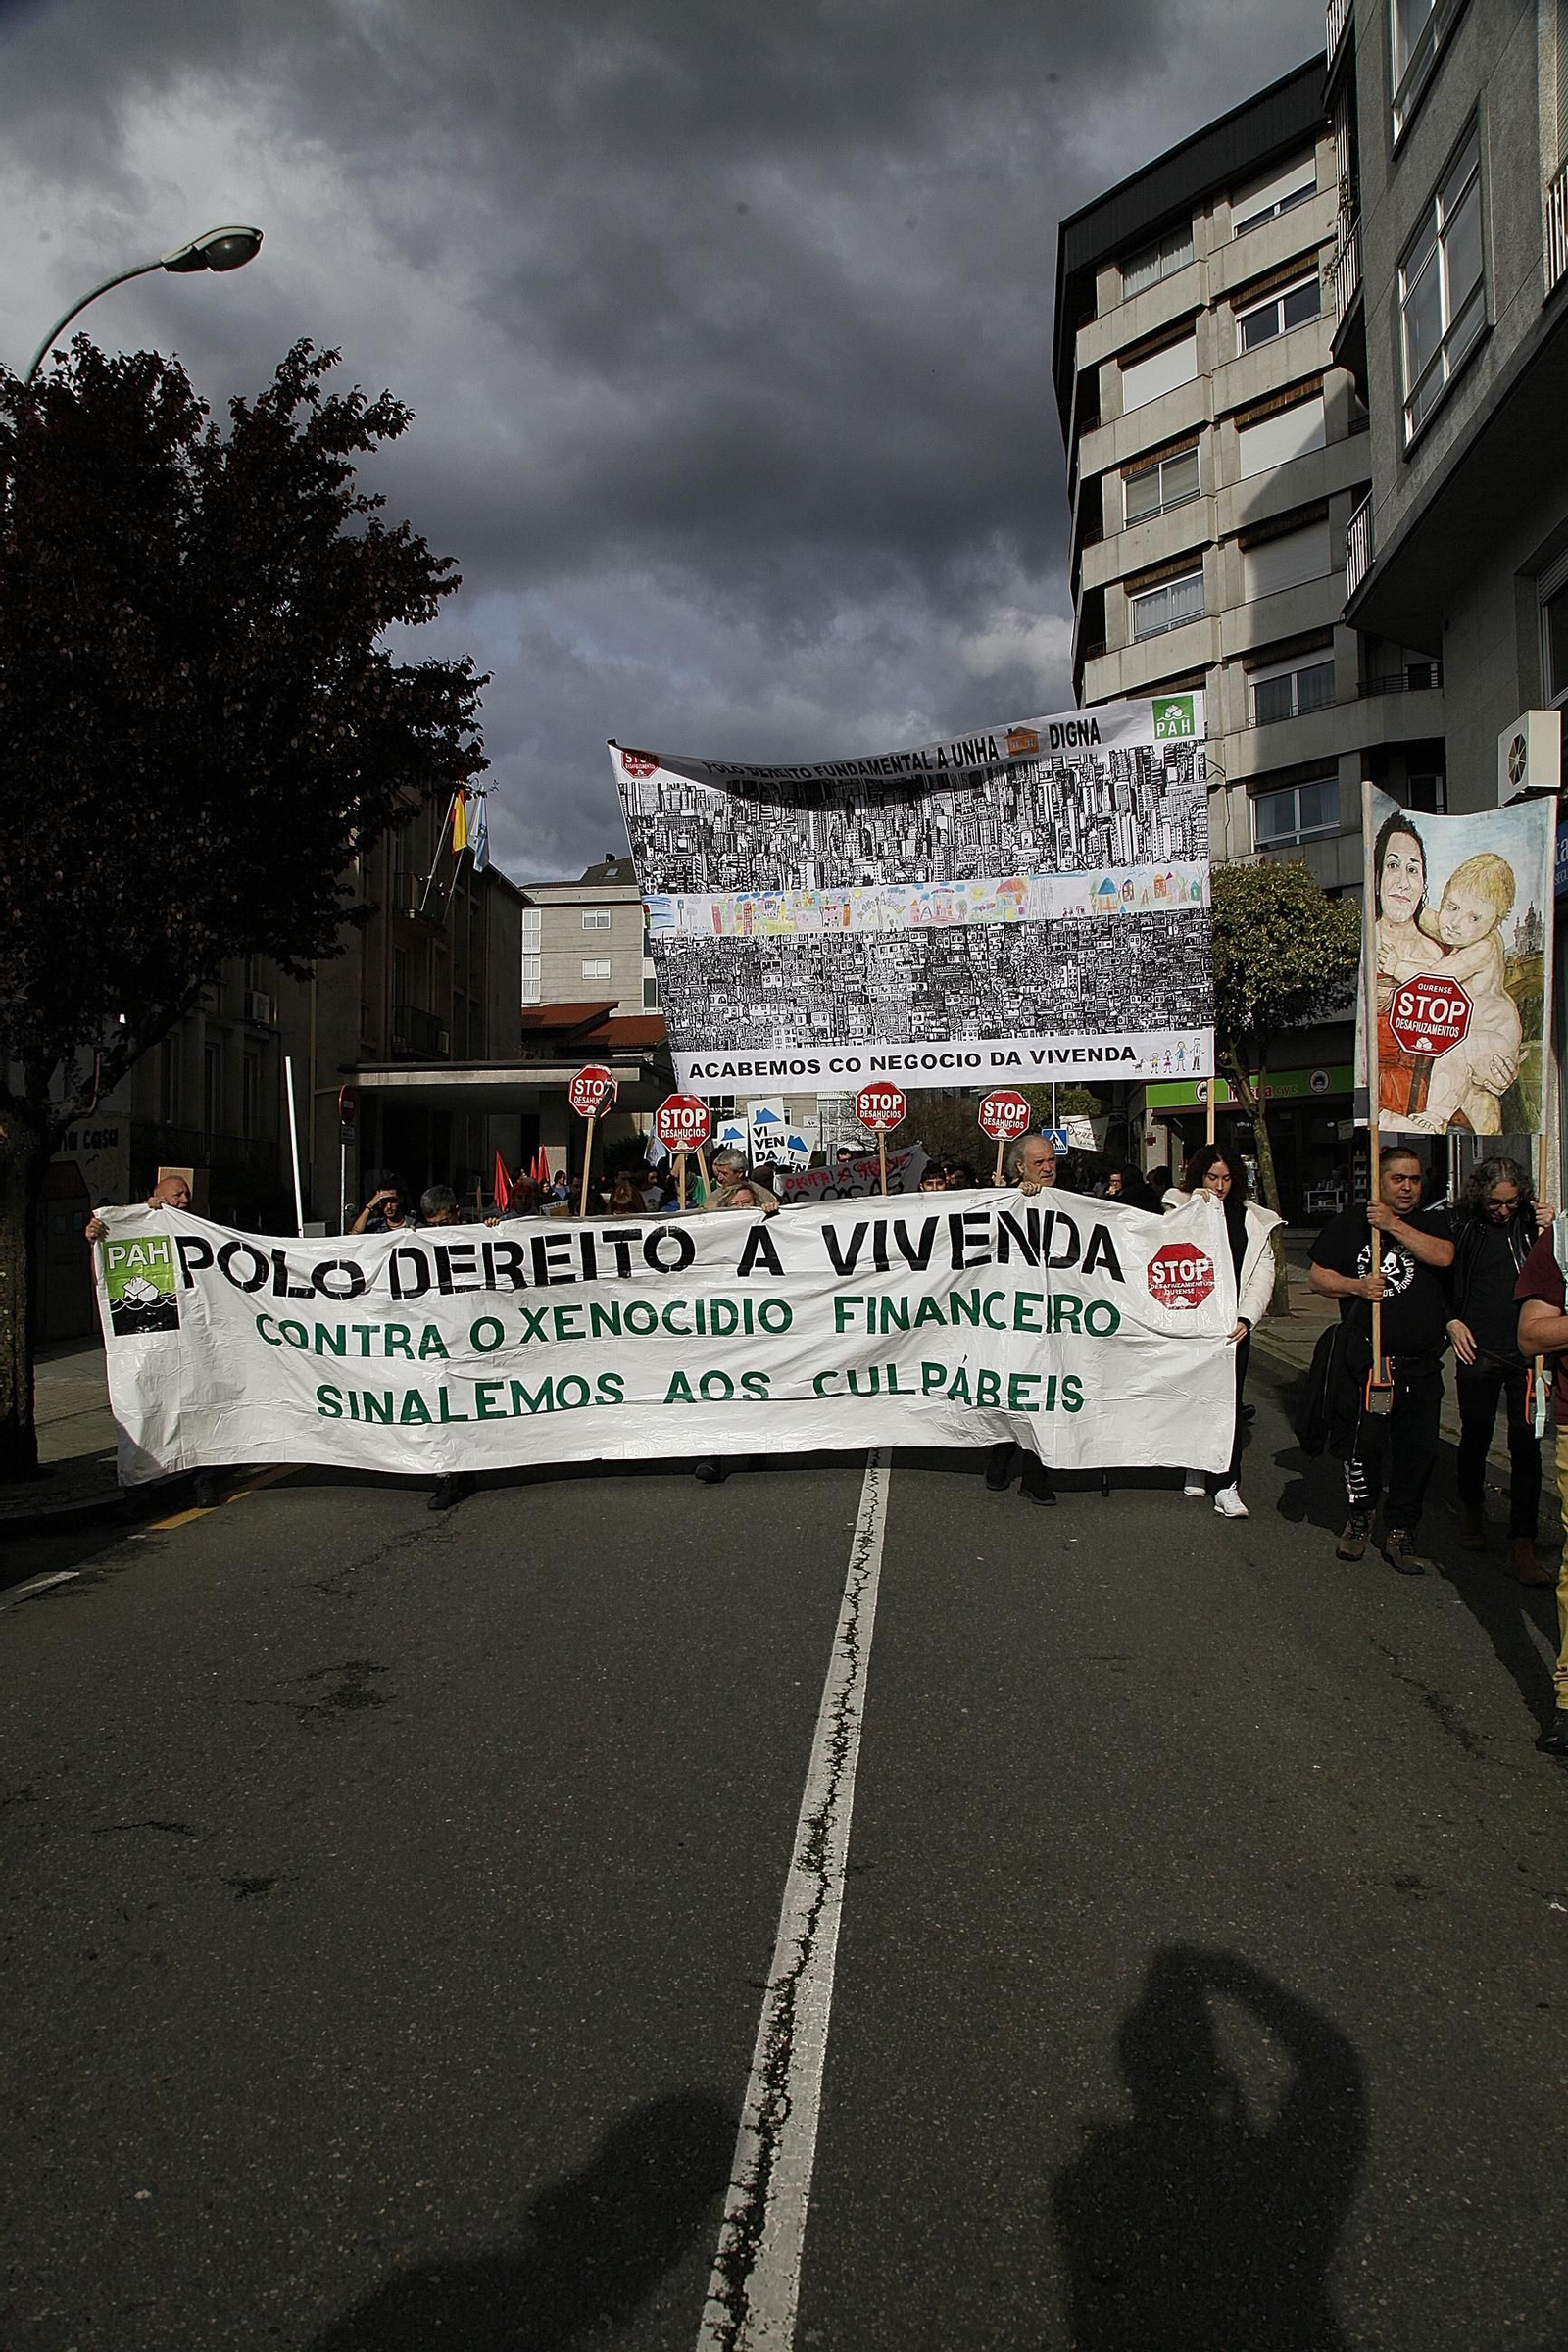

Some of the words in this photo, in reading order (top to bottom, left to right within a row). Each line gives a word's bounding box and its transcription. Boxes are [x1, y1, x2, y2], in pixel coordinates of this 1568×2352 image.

[1156, 719, 1192, 738] PAH
[703, 761, 745, 775] POLO
[745, 765, 812, 780] DEREITO
[814, 753, 933, 778] FUNDAMENTAL
[938, 746, 950, 769] A
[953, 735, 1000, 768] UNHA
[1048, 717, 1102, 750] DIGNA
[1417, 982, 1453, 994] OURENSE
[1398, 992, 1466, 1024] STOP
[1396, 1016, 1460, 1039] DESAFIUZAMENTOS
[689, 1058, 821, 1079] ACABEMOS
[828, 1057, 862, 1073] CO
[869, 1053, 982, 1071] NEGOCIO
[990, 1051, 1022, 1067] DA
[1029, 1046, 1137, 1065] VIVENDA
[574, 1079, 610, 1097] STO
[859, 1093, 903, 1110] STOP
[983, 1100, 1027, 1120] STOP
[660, 1108, 707, 1129] STOP
[859, 1108, 902, 1119] DESAHUCIOS
[982, 1117, 1025, 1129] DESAHUCIOS
[661, 1127, 707, 1139] DESAHUCIOS
[753, 1126, 768, 1138] VI
[754, 1135, 785, 1151] VEN
[755, 1150, 778, 1163] DA
[108, 1243, 170, 1270] PAH
[174, 1236, 367, 1300] POLO
[389, 1226, 696, 1300] DEREITO
[737, 1225, 786, 1277] A
[821, 1207, 1126, 1283] VIVENDA
[1152, 1258, 1210, 1284] STOP
[256, 1313, 451, 1360] CONTRA
[469, 1316, 505, 1352] O
[518, 1298, 793, 1344] XENOCIDIO
[834, 1289, 1121, 1337] FINANCEIRO
[316, 1372, 625, 1424] SINALEMOS
[663, 1370, 771, 1403] AOS
[812, 1354, 1084, 1413] CULPÁBEIS
